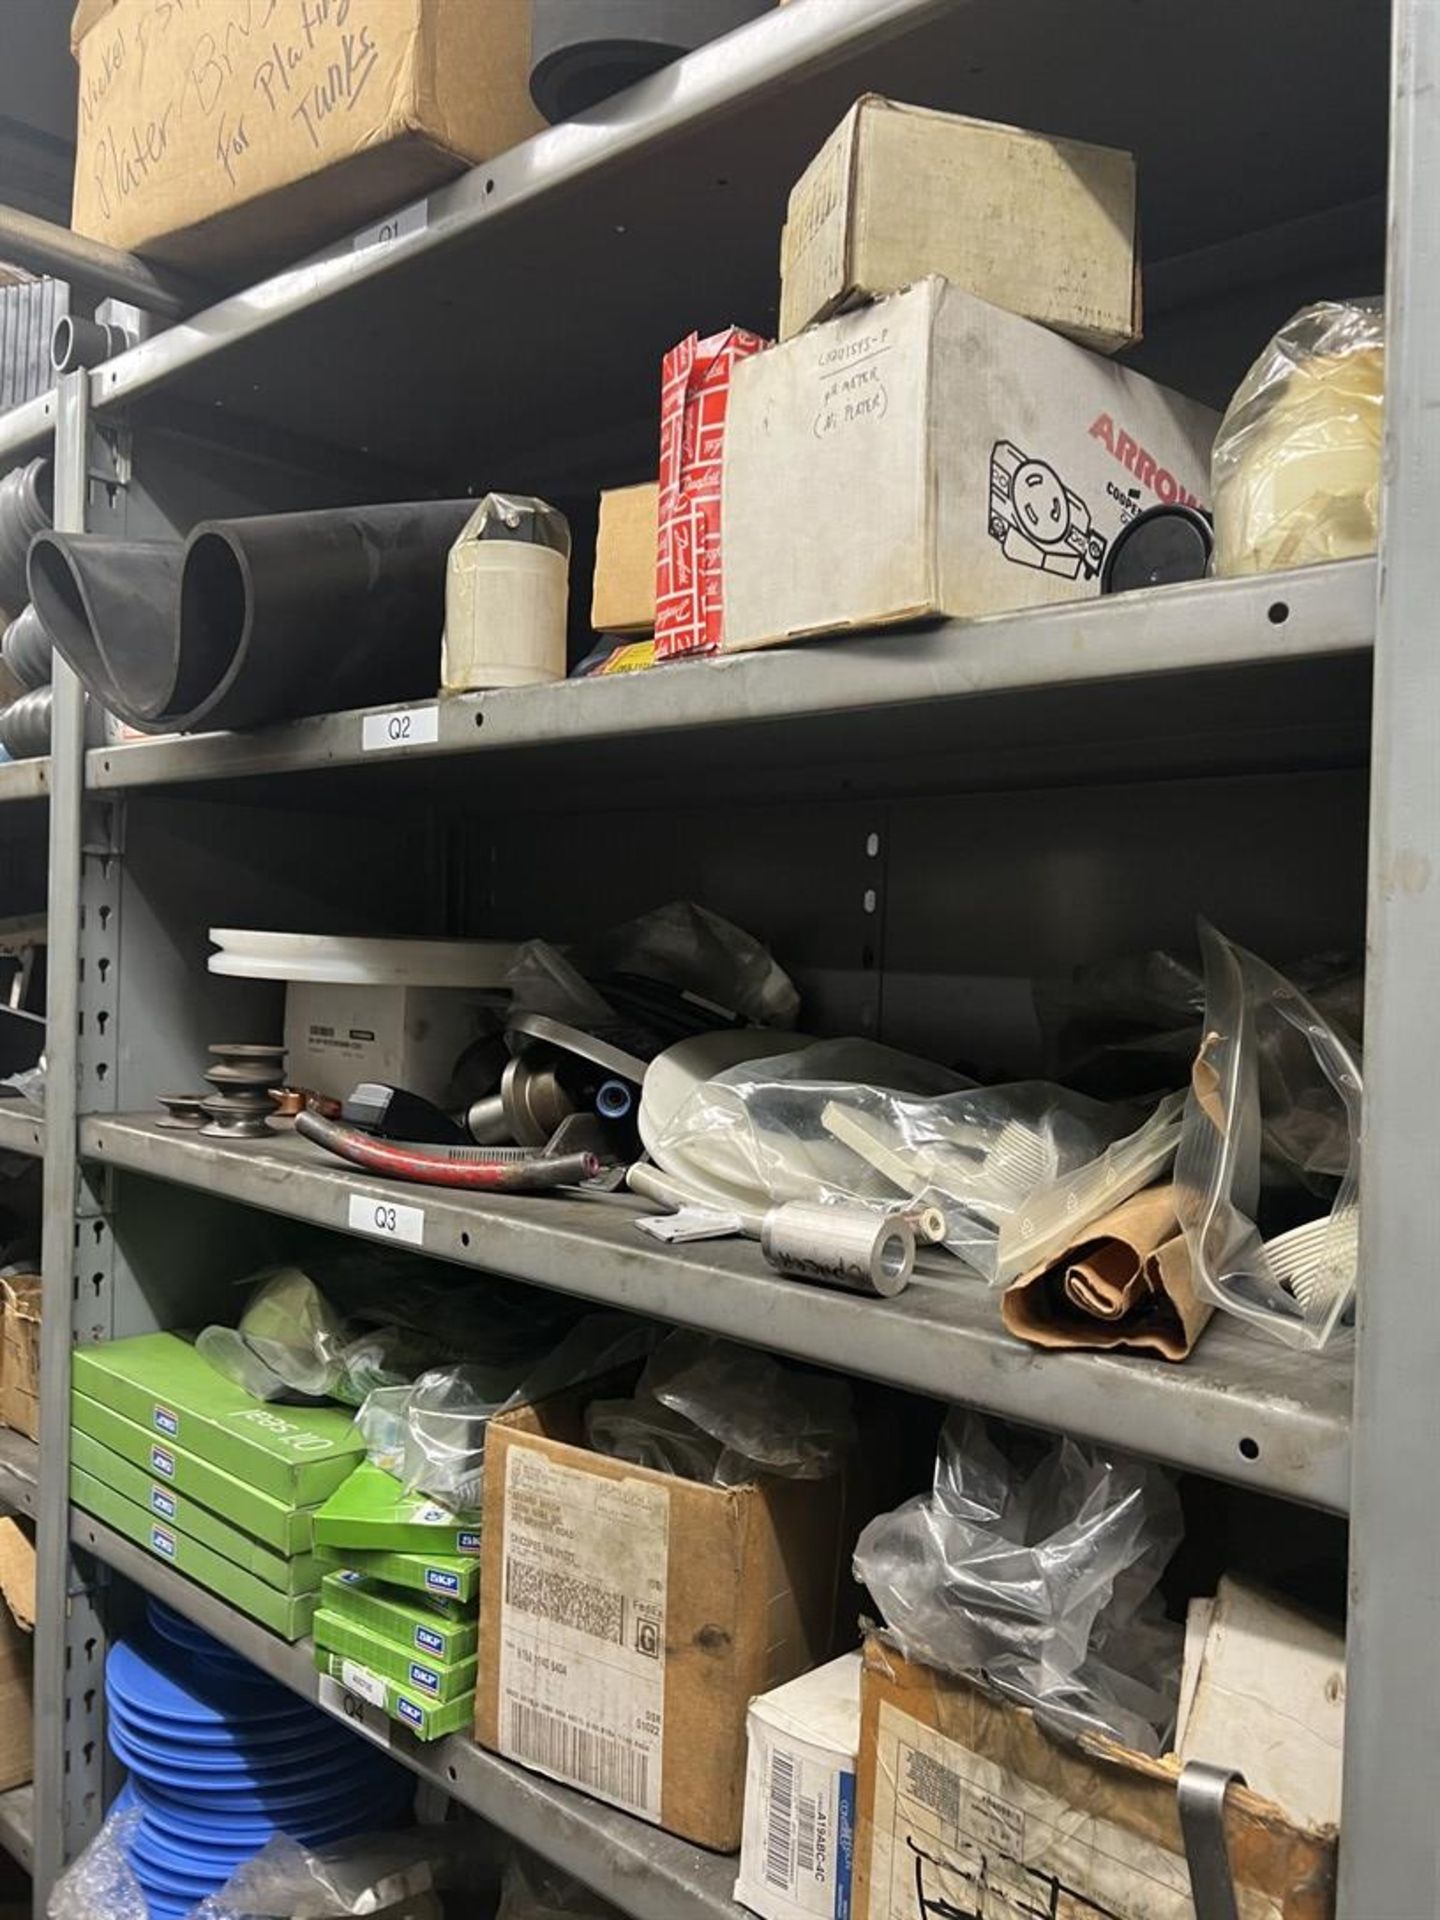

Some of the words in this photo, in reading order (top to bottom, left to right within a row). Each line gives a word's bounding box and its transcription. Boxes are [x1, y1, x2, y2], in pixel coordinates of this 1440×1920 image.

[388, 716, 410, 740] Q2
[375, 1206, 396, 1231] Q3
[430, 1573, 456, 1587] SKF
[418, 1631, 441, 1647] SKF
[640, 1625, 656, 1654] G
[412, 1668, 436, 1685] SKF
[343, 1694, 364, 1722] Q4
[400, 1701, 422, 1720] SKF
